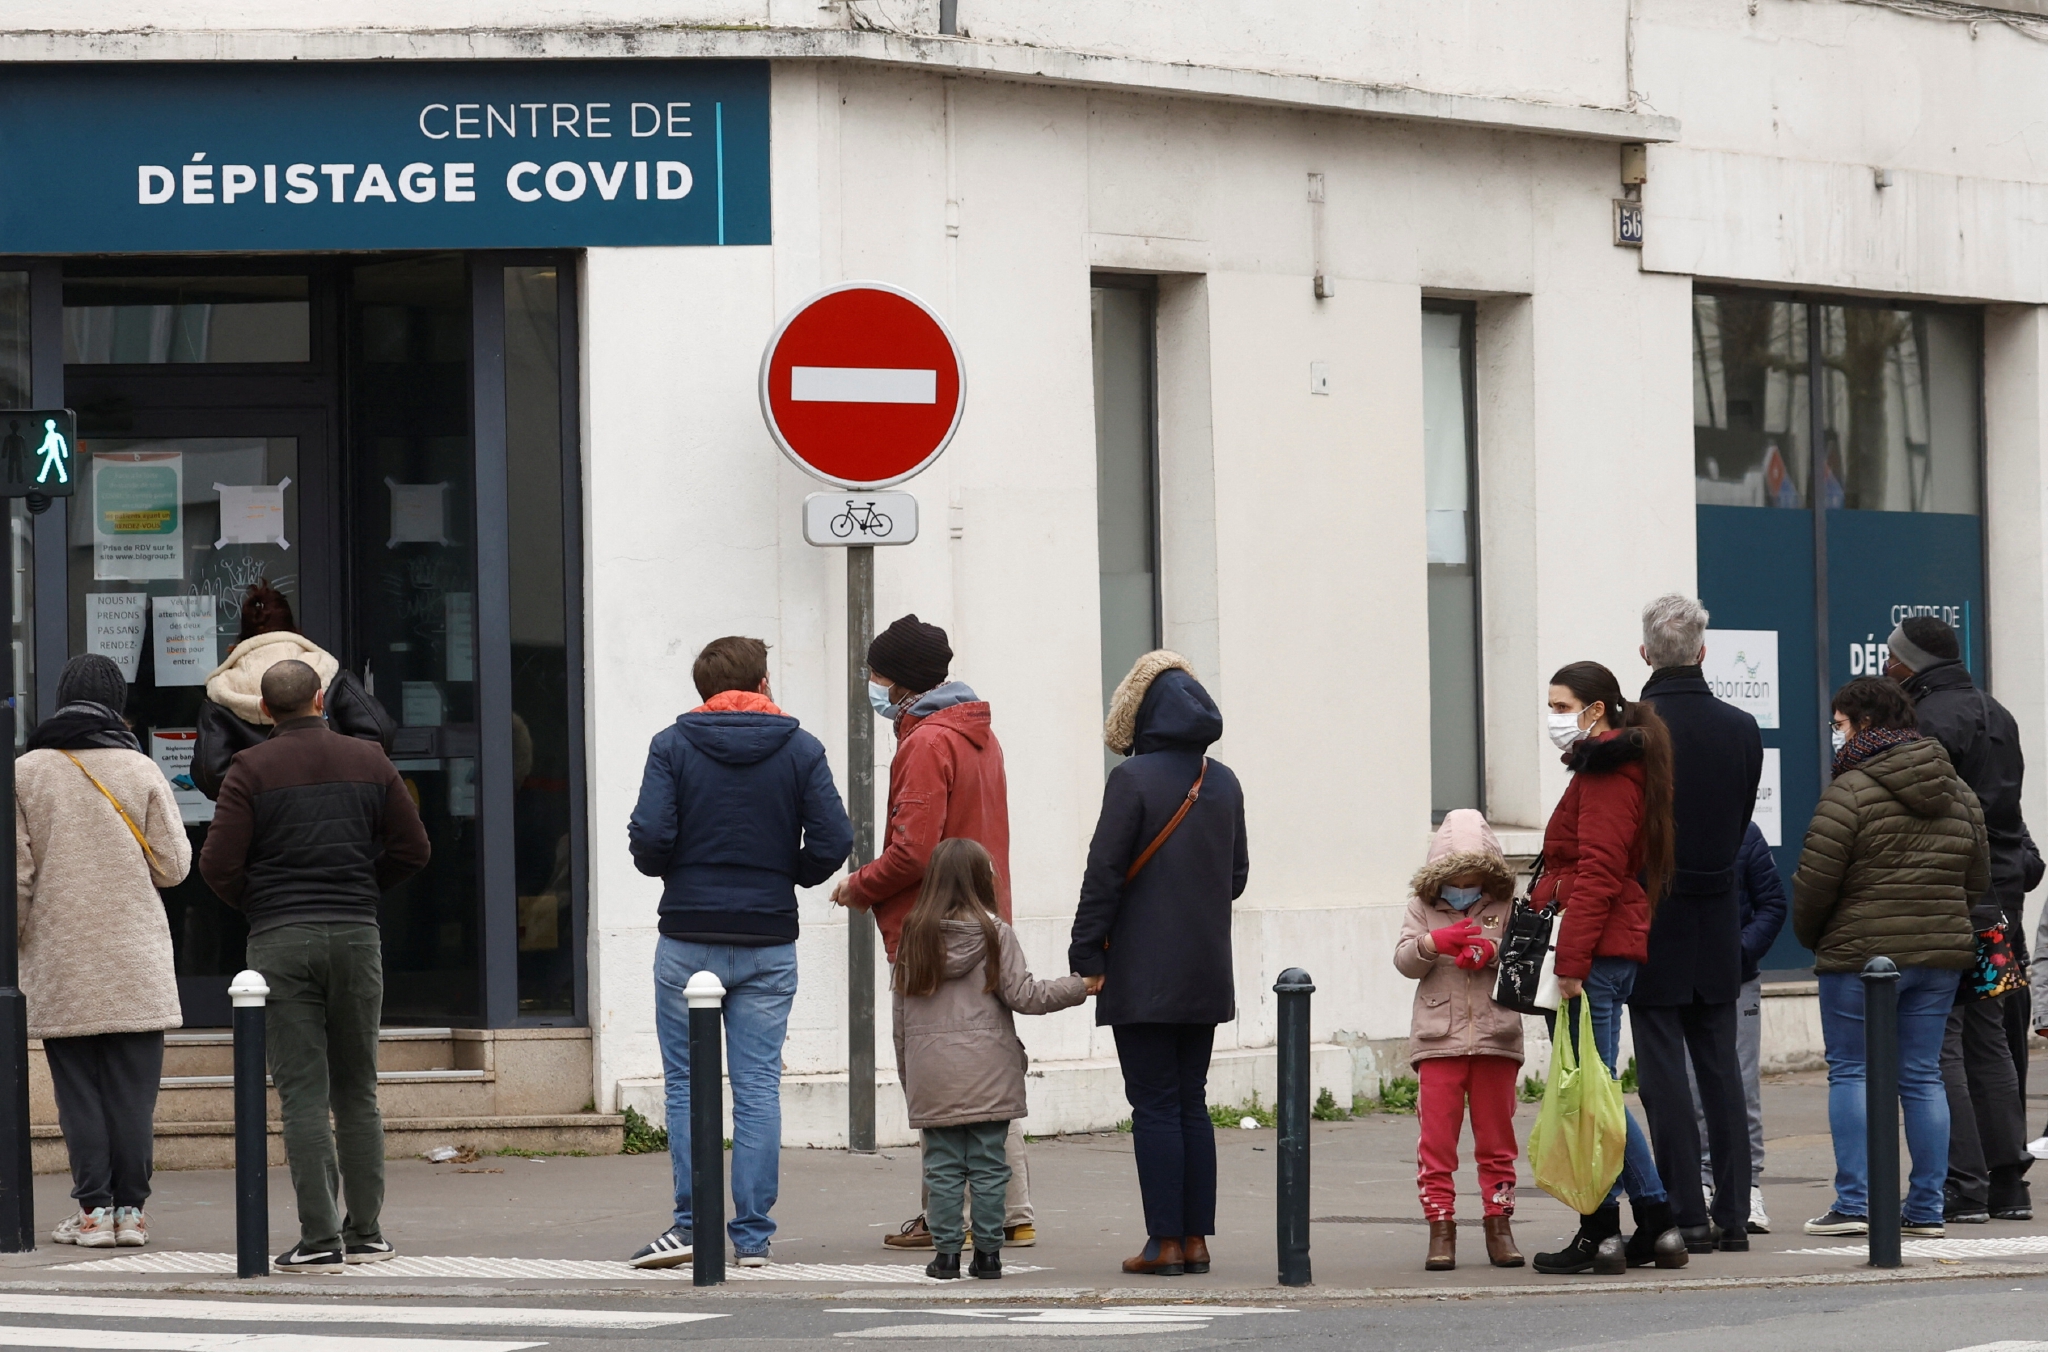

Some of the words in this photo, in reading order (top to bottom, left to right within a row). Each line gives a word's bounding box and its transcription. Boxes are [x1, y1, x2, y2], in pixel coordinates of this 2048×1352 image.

[419, 102, 611, 138] CENTRE
[632, 102, 693, 137] DE
[138, 151, 476, 205] DÉPISTAGE
[507, 160, 694, 202] COVID
[1622, 209, 1641, 238] 56
[115, 512, 140, 520] patients
[142, 512, 161, 520] ayant
[100, 552, 114, 560] site
[97, 596, 124, 605] NOUS
[126, 596, 137, 605] NE
[97, 611, 140, 620] PRENONS
[1943, 605, 1960, 628] DE
[97, 626, 114, 634] PAS
[117, 626, 140, 634] SANS
[165, 635, 196, 643] guichets
[100, 641, 138, 649] RENDEZ-
[110, 655, 129, 664] OUS
